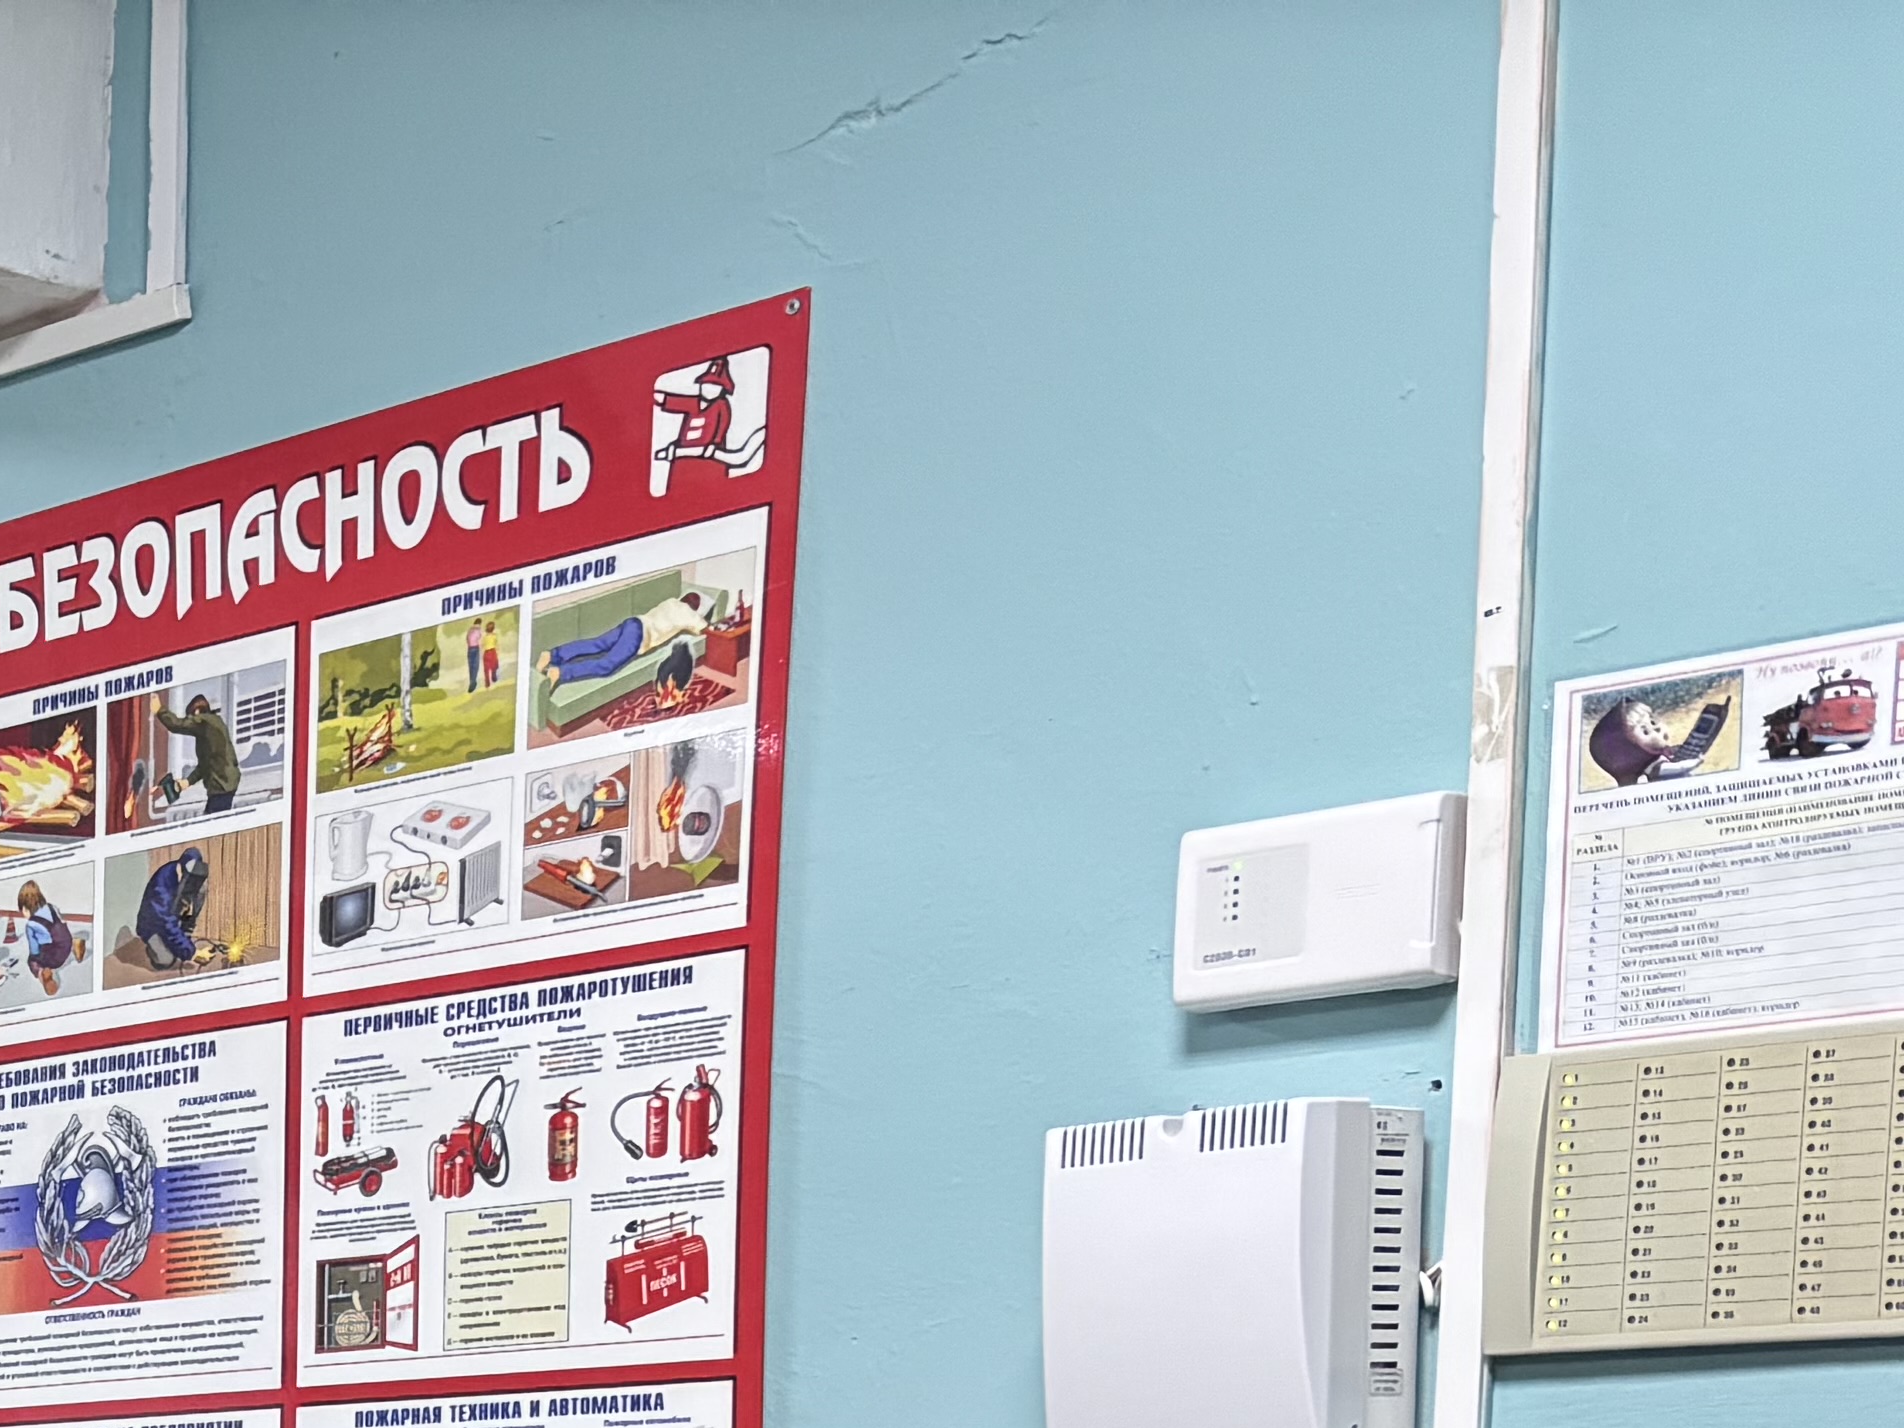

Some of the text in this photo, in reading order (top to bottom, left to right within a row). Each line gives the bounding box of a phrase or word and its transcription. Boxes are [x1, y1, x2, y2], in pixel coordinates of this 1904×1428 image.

[442, 556, 616, 616] ПРИЧИНЫ ПОЖАРОВ
[33, 666, 173, 715] ПРИЧИНЫ ПОЖАРОВ
[344, 965, 693, 1037] ПЕРВИЧНЫЕ СРЕДСТВА ПОЖАРОТУШЕНИЯ
[443, 1007, 581, 1037] ОГНЕТУШИТЕЛИ
[72, 1040, 216, 1082] ЗАКОНОДАТЕЛЬСТВА
[11, 1081, 85, 1108] ПОЖАРНОЙ
[92, 1066, 198, 1097] БЕЗОПАСНОСТИ
[355, 1392, 664, 1428] ПОЖАРНАЯ ТЕХНИКА И АВТОМАТИКА
